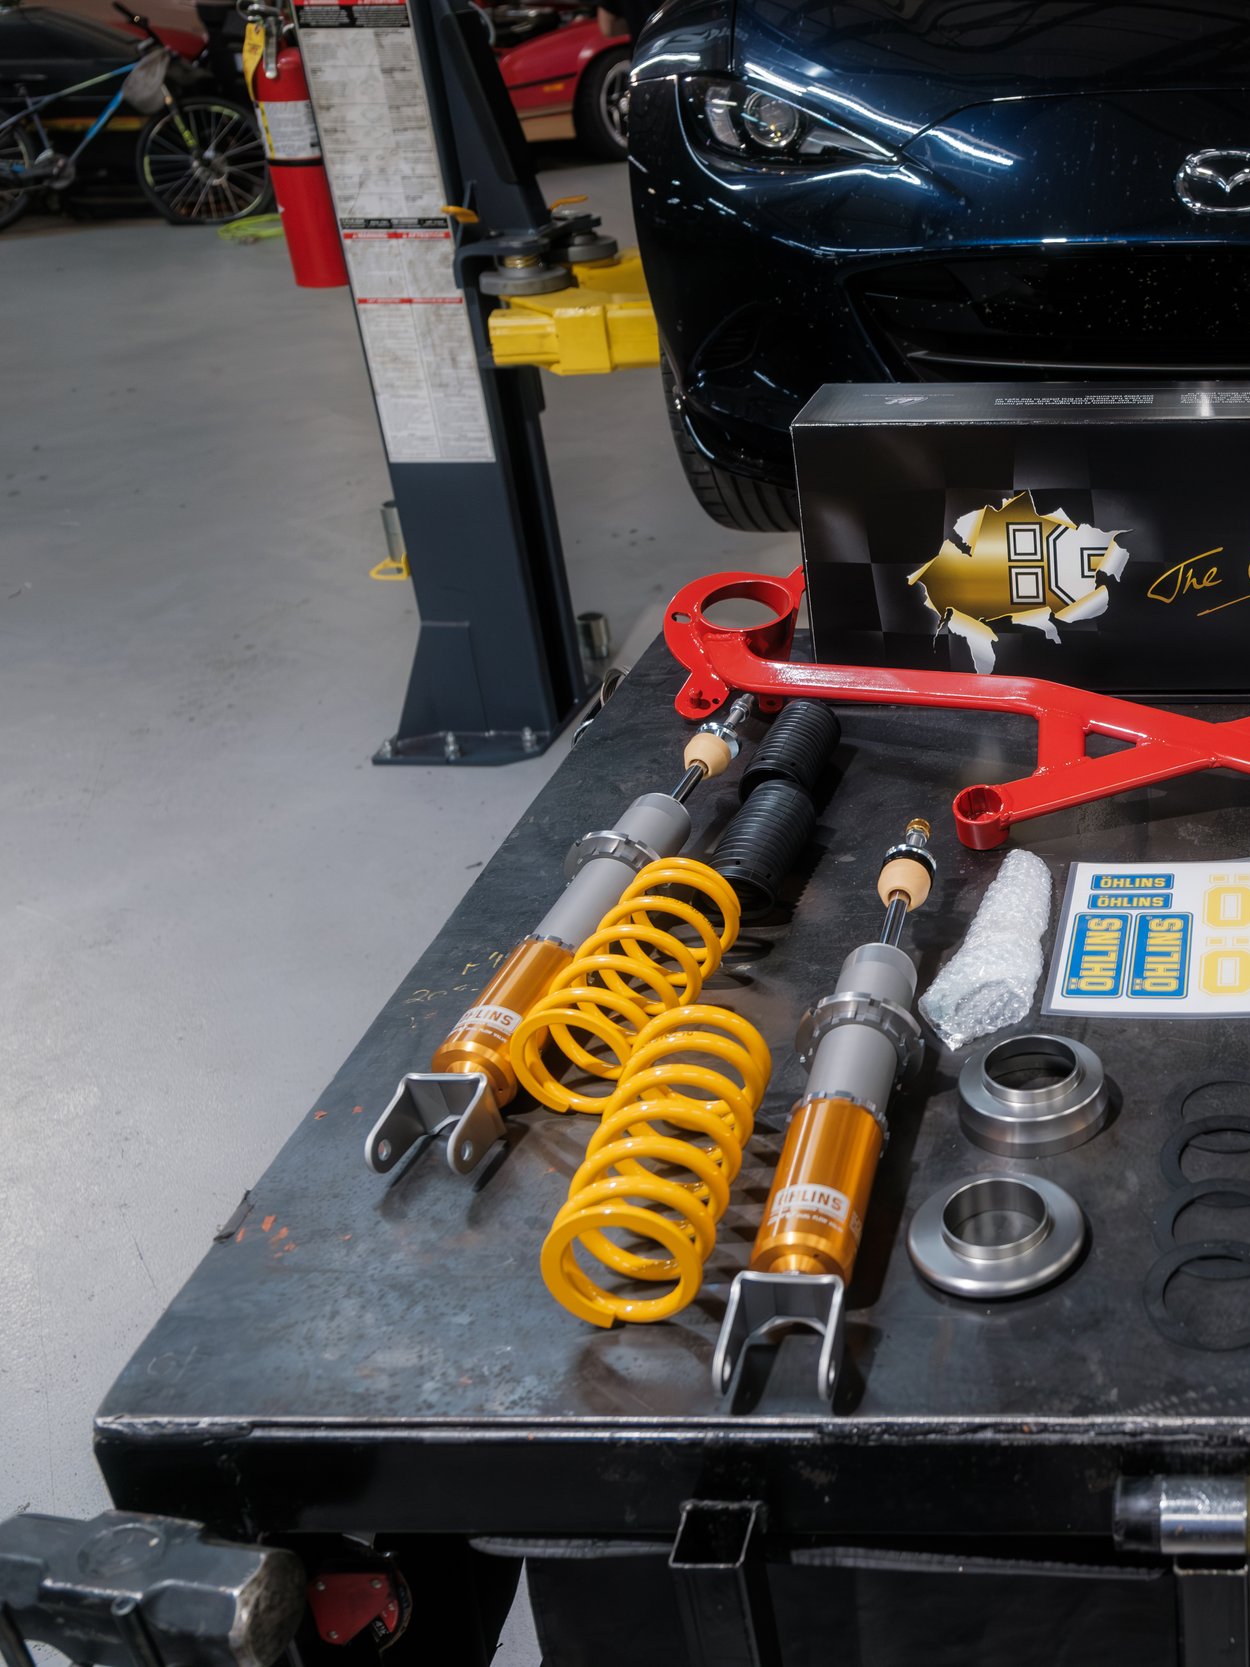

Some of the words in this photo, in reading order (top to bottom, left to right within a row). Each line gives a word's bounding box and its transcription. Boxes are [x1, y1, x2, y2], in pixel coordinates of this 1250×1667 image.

[1147, 547, 1224, 604] The
[1097, 895, 1165, 907] ÖHLINS
[1100, 876, 1166, 888] ÖHLINS
[1068, 917, 1123, 991] ÖHLINS
[1133, 917, 1184, 992] ÖHLINS
